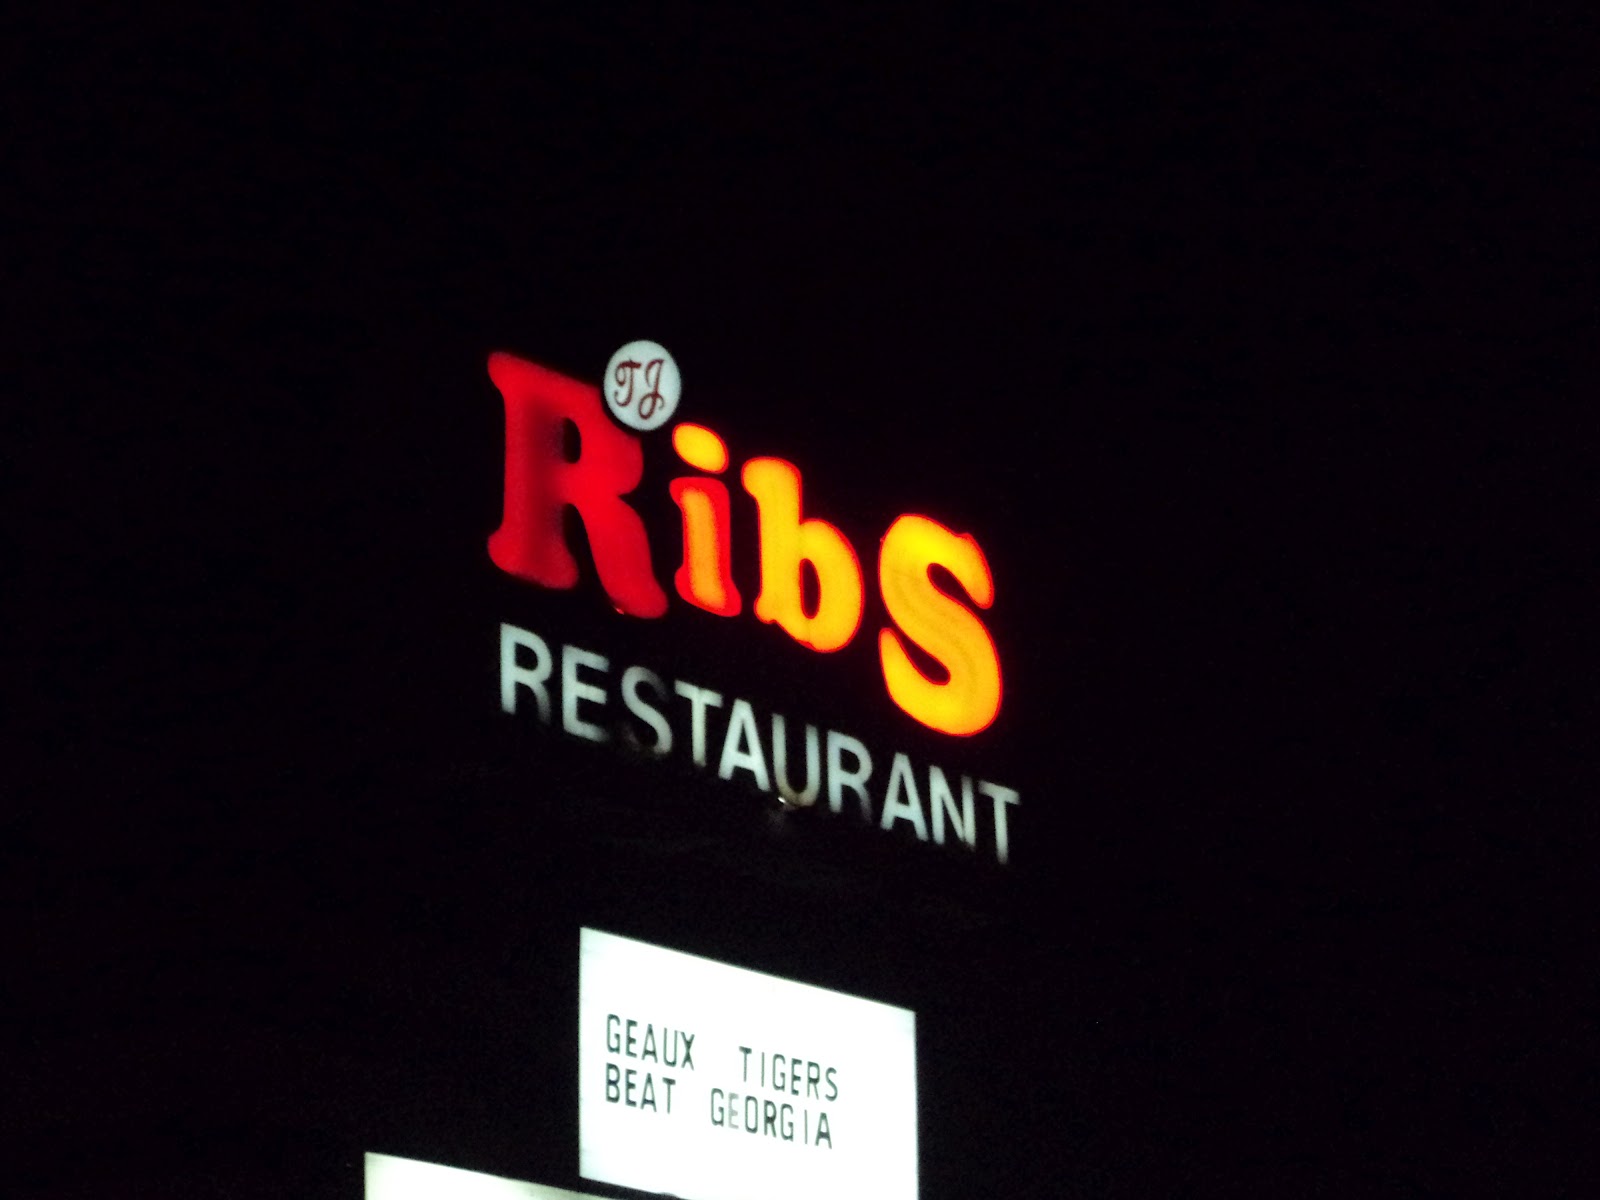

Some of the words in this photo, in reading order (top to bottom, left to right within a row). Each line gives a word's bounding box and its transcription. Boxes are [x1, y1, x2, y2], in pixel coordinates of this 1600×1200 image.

[614, 358, 665, 420] TJ
[500, 622, 1020, 864] RESTAURANT
[606, 1013, 695, 1071] GEAUX
[738, 1045, 838, 1102] TIGERS
[605, 1062, 676, 1115] BEAT
[710, 1087, 833, 1150] GEORGIA
